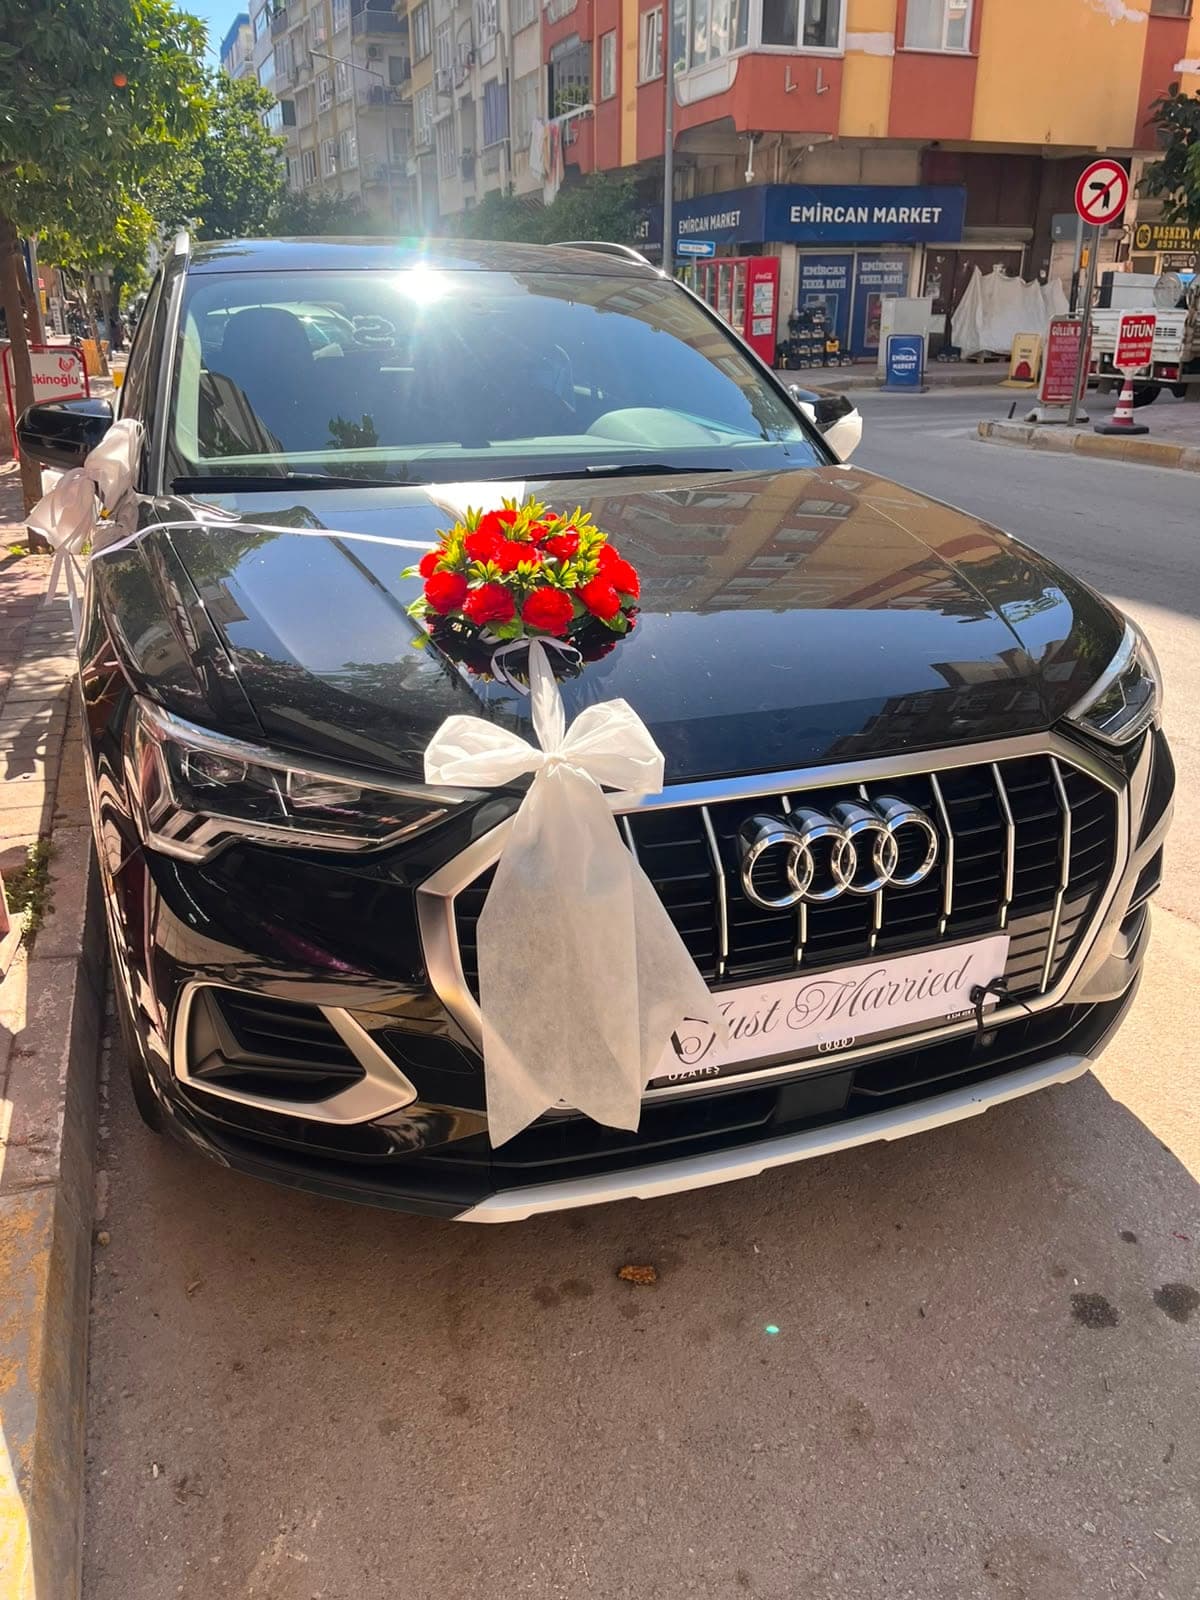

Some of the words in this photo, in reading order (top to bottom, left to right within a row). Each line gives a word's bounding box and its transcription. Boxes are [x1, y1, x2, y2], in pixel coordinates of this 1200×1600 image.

[679, 216, 709, 235] EMİRCAN
[710, 210, 741, 231] MARKET
[790, 202, 868, 223] EMİRCAN
[873, 207, 942, 224] MARKET
[1122, 320, 1154, 338] TÜTÜN
[32, 374, 78, 387] skinoğlu
[786, 954, 973, 1030] Married
